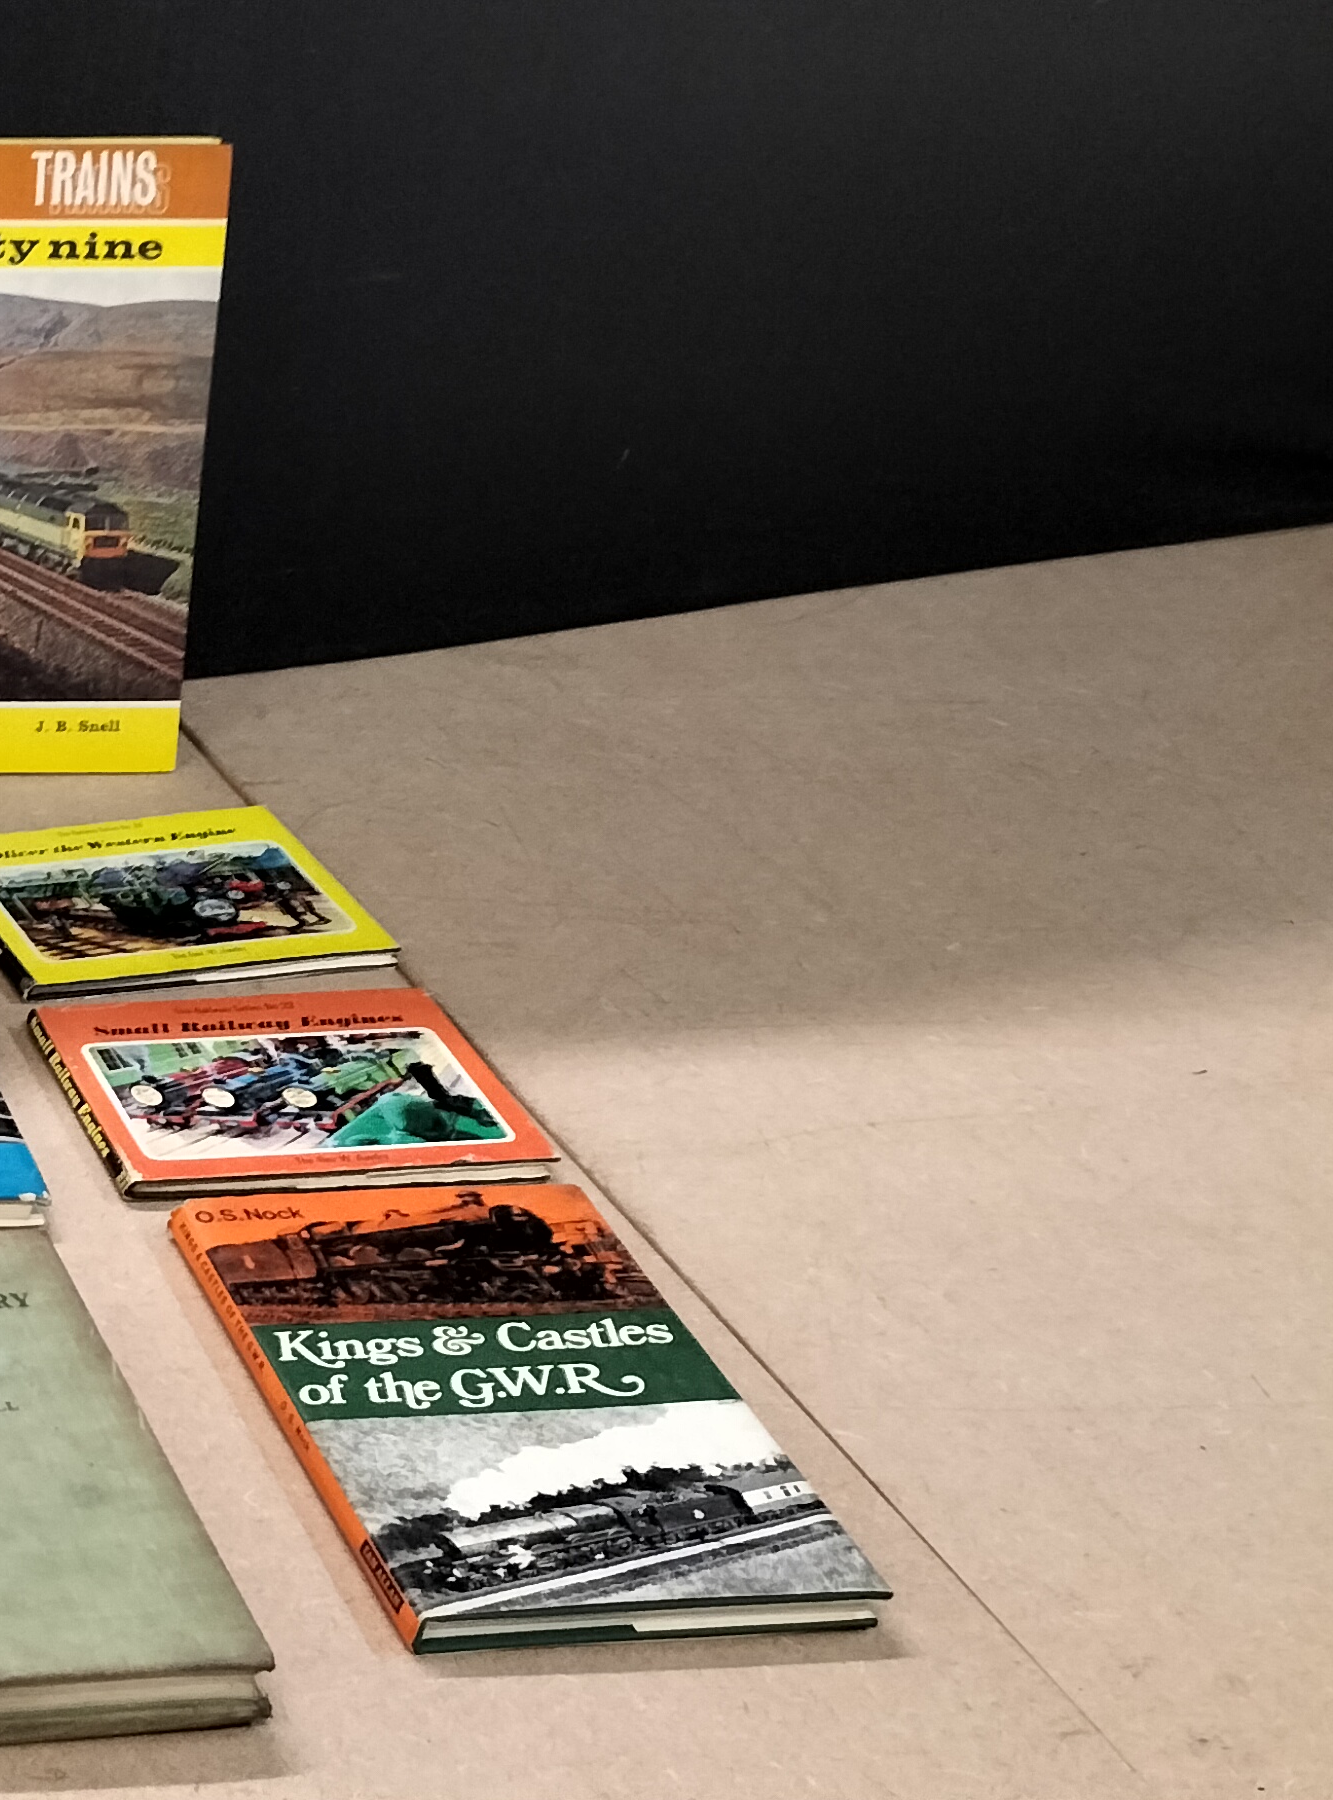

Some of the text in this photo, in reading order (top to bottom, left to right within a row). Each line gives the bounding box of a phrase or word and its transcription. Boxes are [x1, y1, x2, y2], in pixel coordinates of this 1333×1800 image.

[31, 150, 161, 208] TRAINS
[48, 232, 163, 261] nine
[78, 719, 120, 732] Snell
[274, 1317, 674, 1369] Kings & Castles
[298, 1375, 347, 1406] of
[366, 1371, 443, 1410] the
